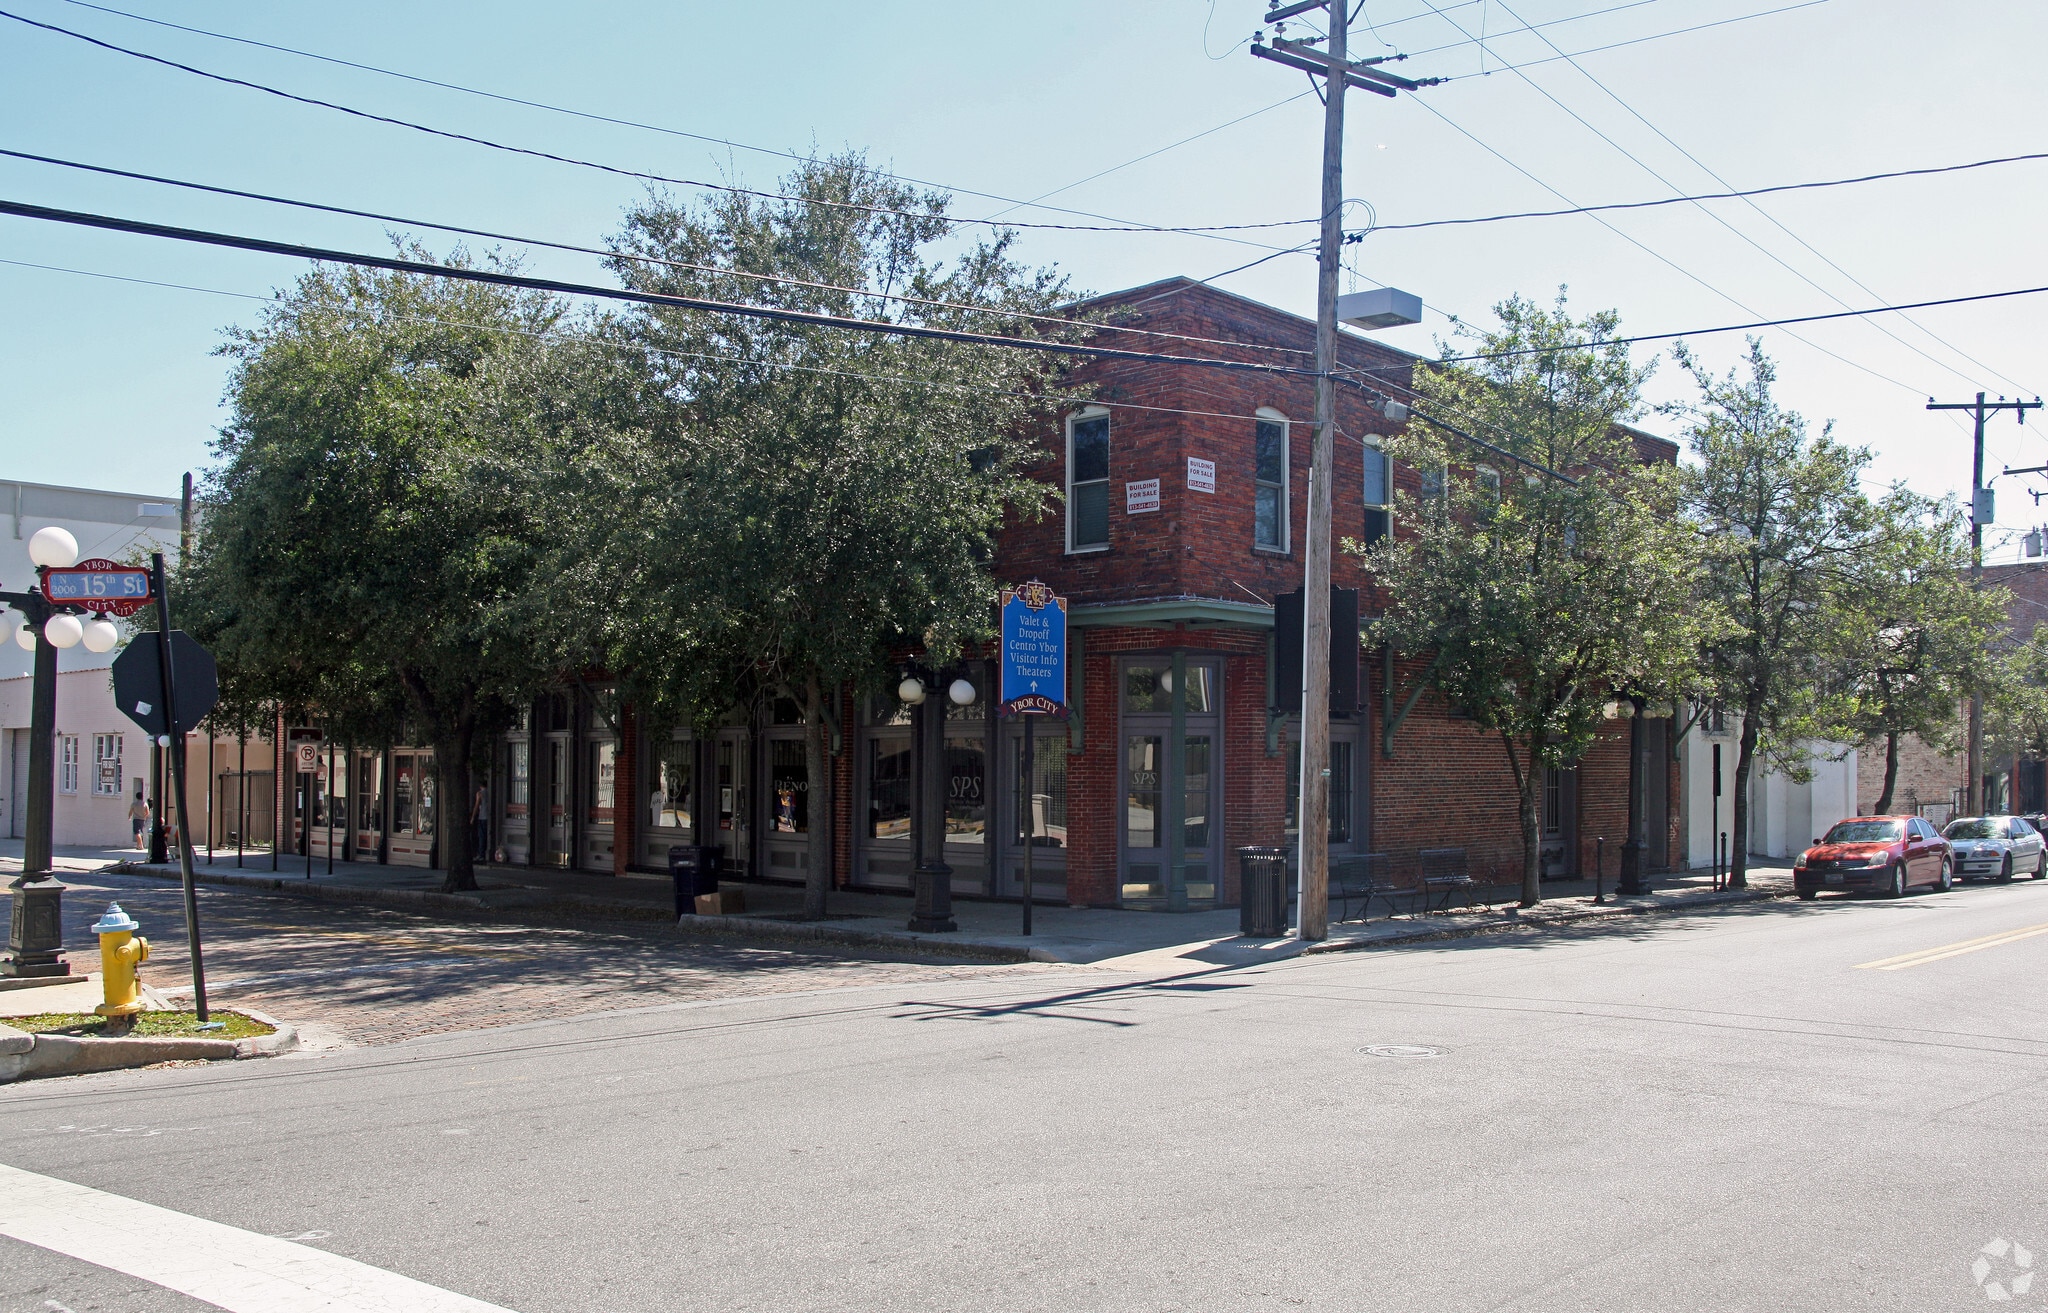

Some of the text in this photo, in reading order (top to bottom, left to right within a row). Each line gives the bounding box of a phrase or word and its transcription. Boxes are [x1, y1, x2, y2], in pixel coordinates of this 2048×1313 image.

[1190, 460, 1213, 470] BUILDING
[1129, 482, 1157, 491] BUILDING
[84, 560, 112, 571] YBOR
[59, 575, 67, 583] N
[81, 574, 144, 596] 15th St
[52, 585, 76, 594] 2000
[87, 600, 117, 610] CITY
[115, 604, 134, 616] CITY
[1019, 615, 1049, 627] Valet &
[1019, 628, 1050, 642] Dropoff
[1009, 640, 1058, 653] Centro Ybor
[1010, 652, 1058, 665] Visitor Info
[1016, 666, 1052, 678] Theaters
[1010, 697, 1059, 715] YBOR CITY
[1132, 772, 1157, 784] SPS
[949, 776, 981, 798] SPS
